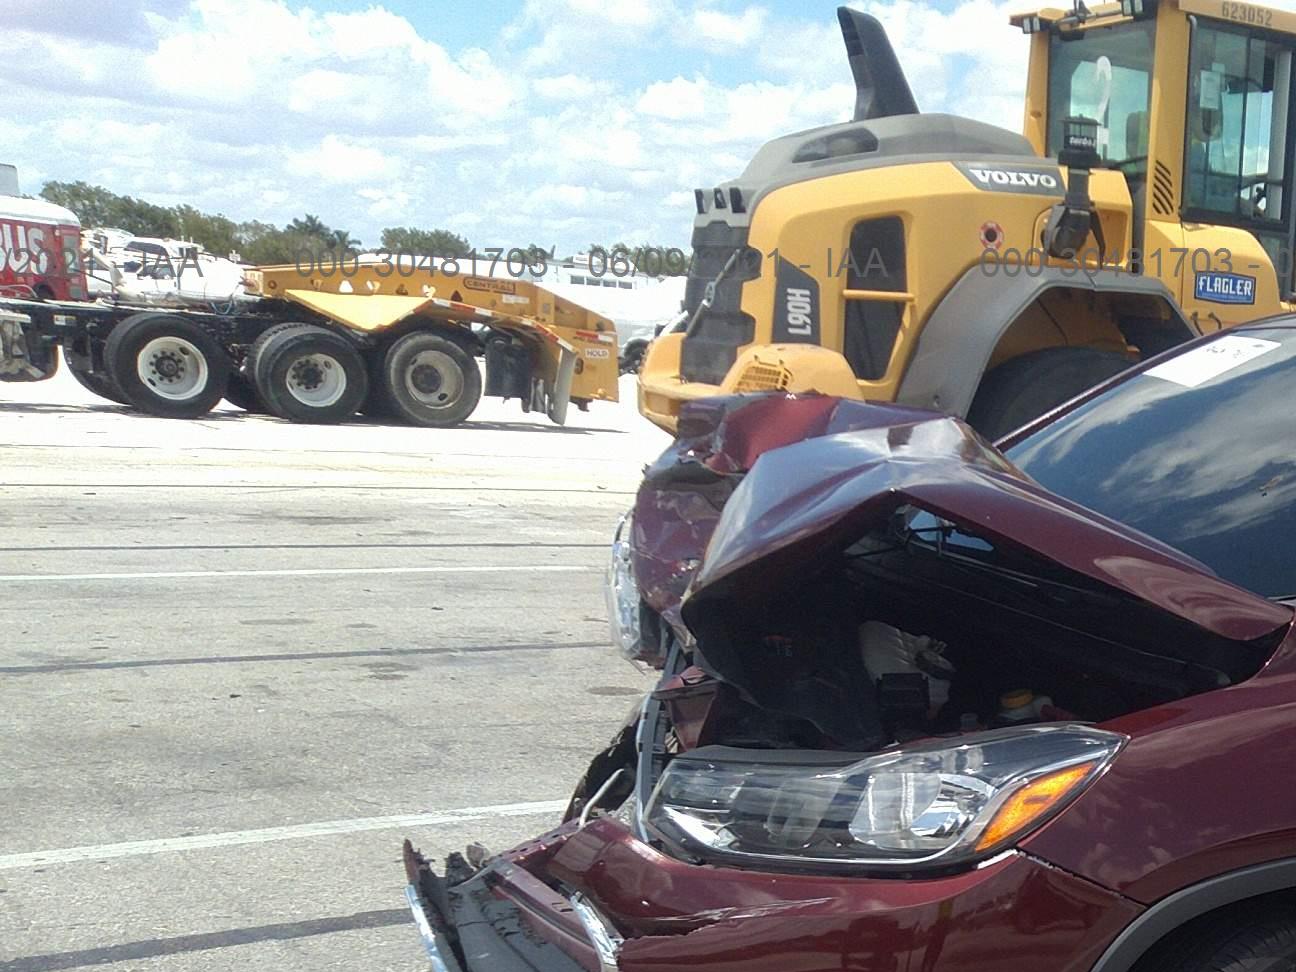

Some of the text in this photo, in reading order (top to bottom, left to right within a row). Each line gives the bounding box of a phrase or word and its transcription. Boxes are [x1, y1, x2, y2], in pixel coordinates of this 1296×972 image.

[1221, 1, 1273, 26] 623052
[968, 168, 1057, 188] VOLVO
[0, 223, 48, 275] US
[1199, 276, 1252, 297] FLAGLER
[786, 288, 812, 335] L90H
